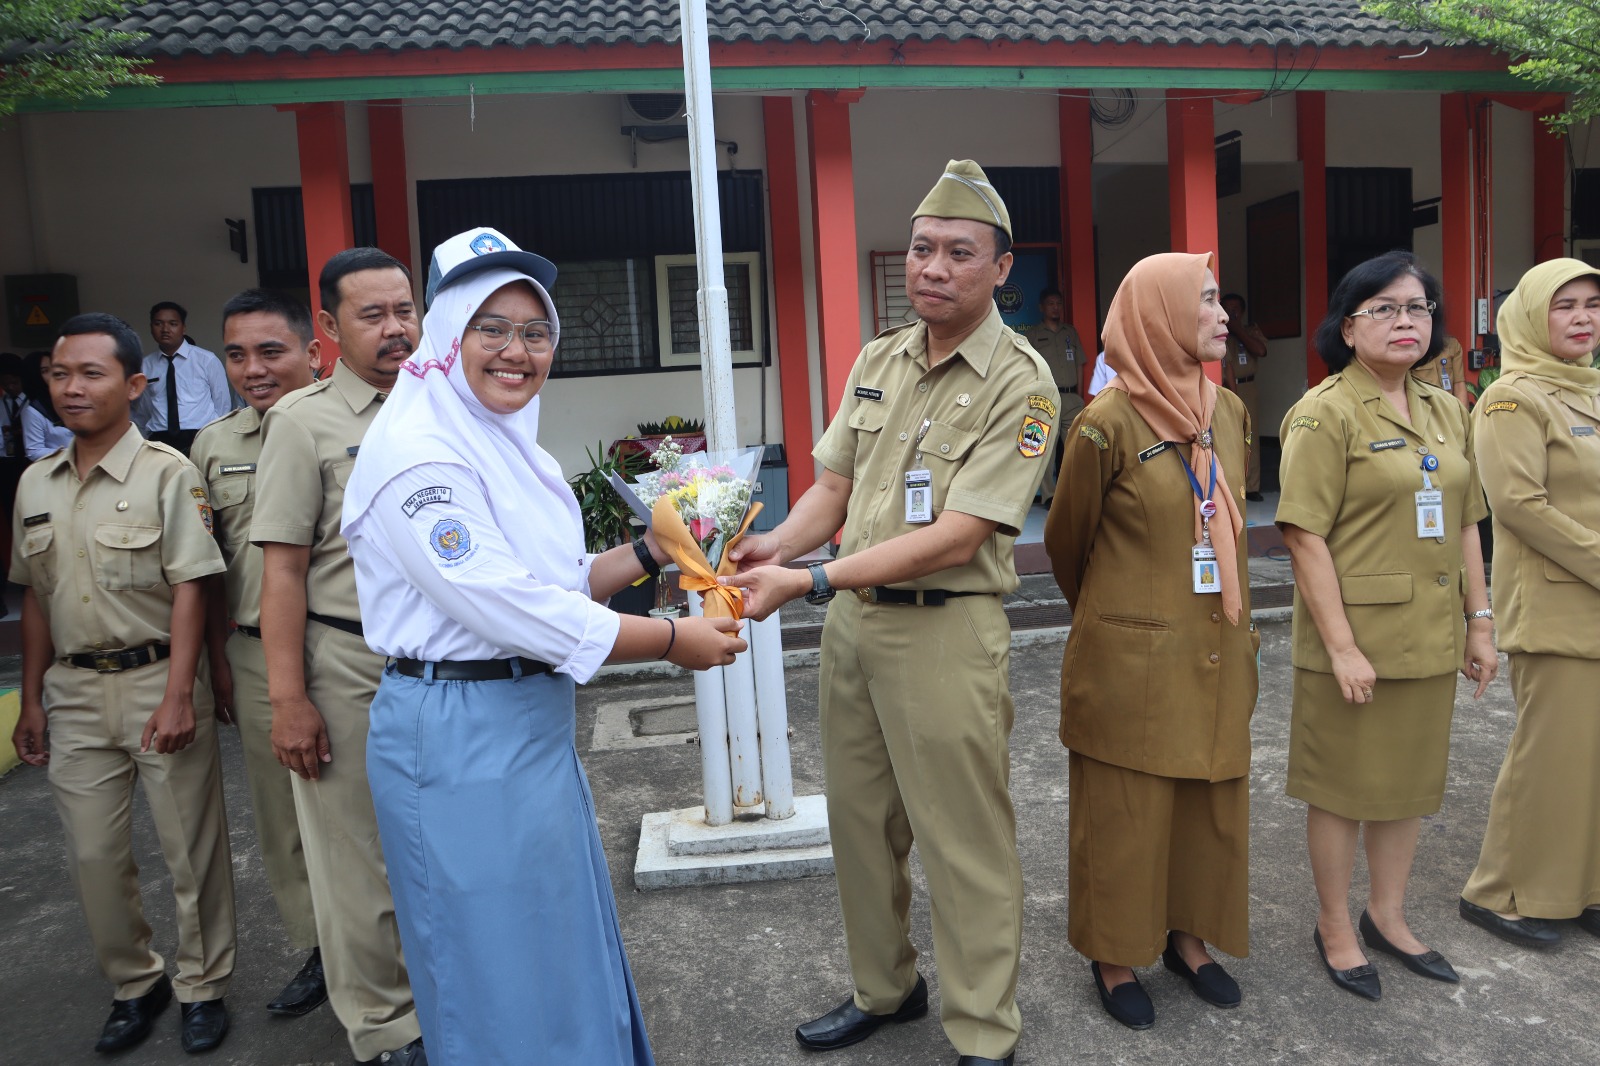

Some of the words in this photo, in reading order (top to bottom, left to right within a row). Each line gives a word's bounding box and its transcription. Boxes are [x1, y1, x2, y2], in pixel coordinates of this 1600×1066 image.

[405, 497, 417, 508] SMA
[417, 489, 439, 498] NEGERI
[413, 495, 441, 509] SEMARANG
